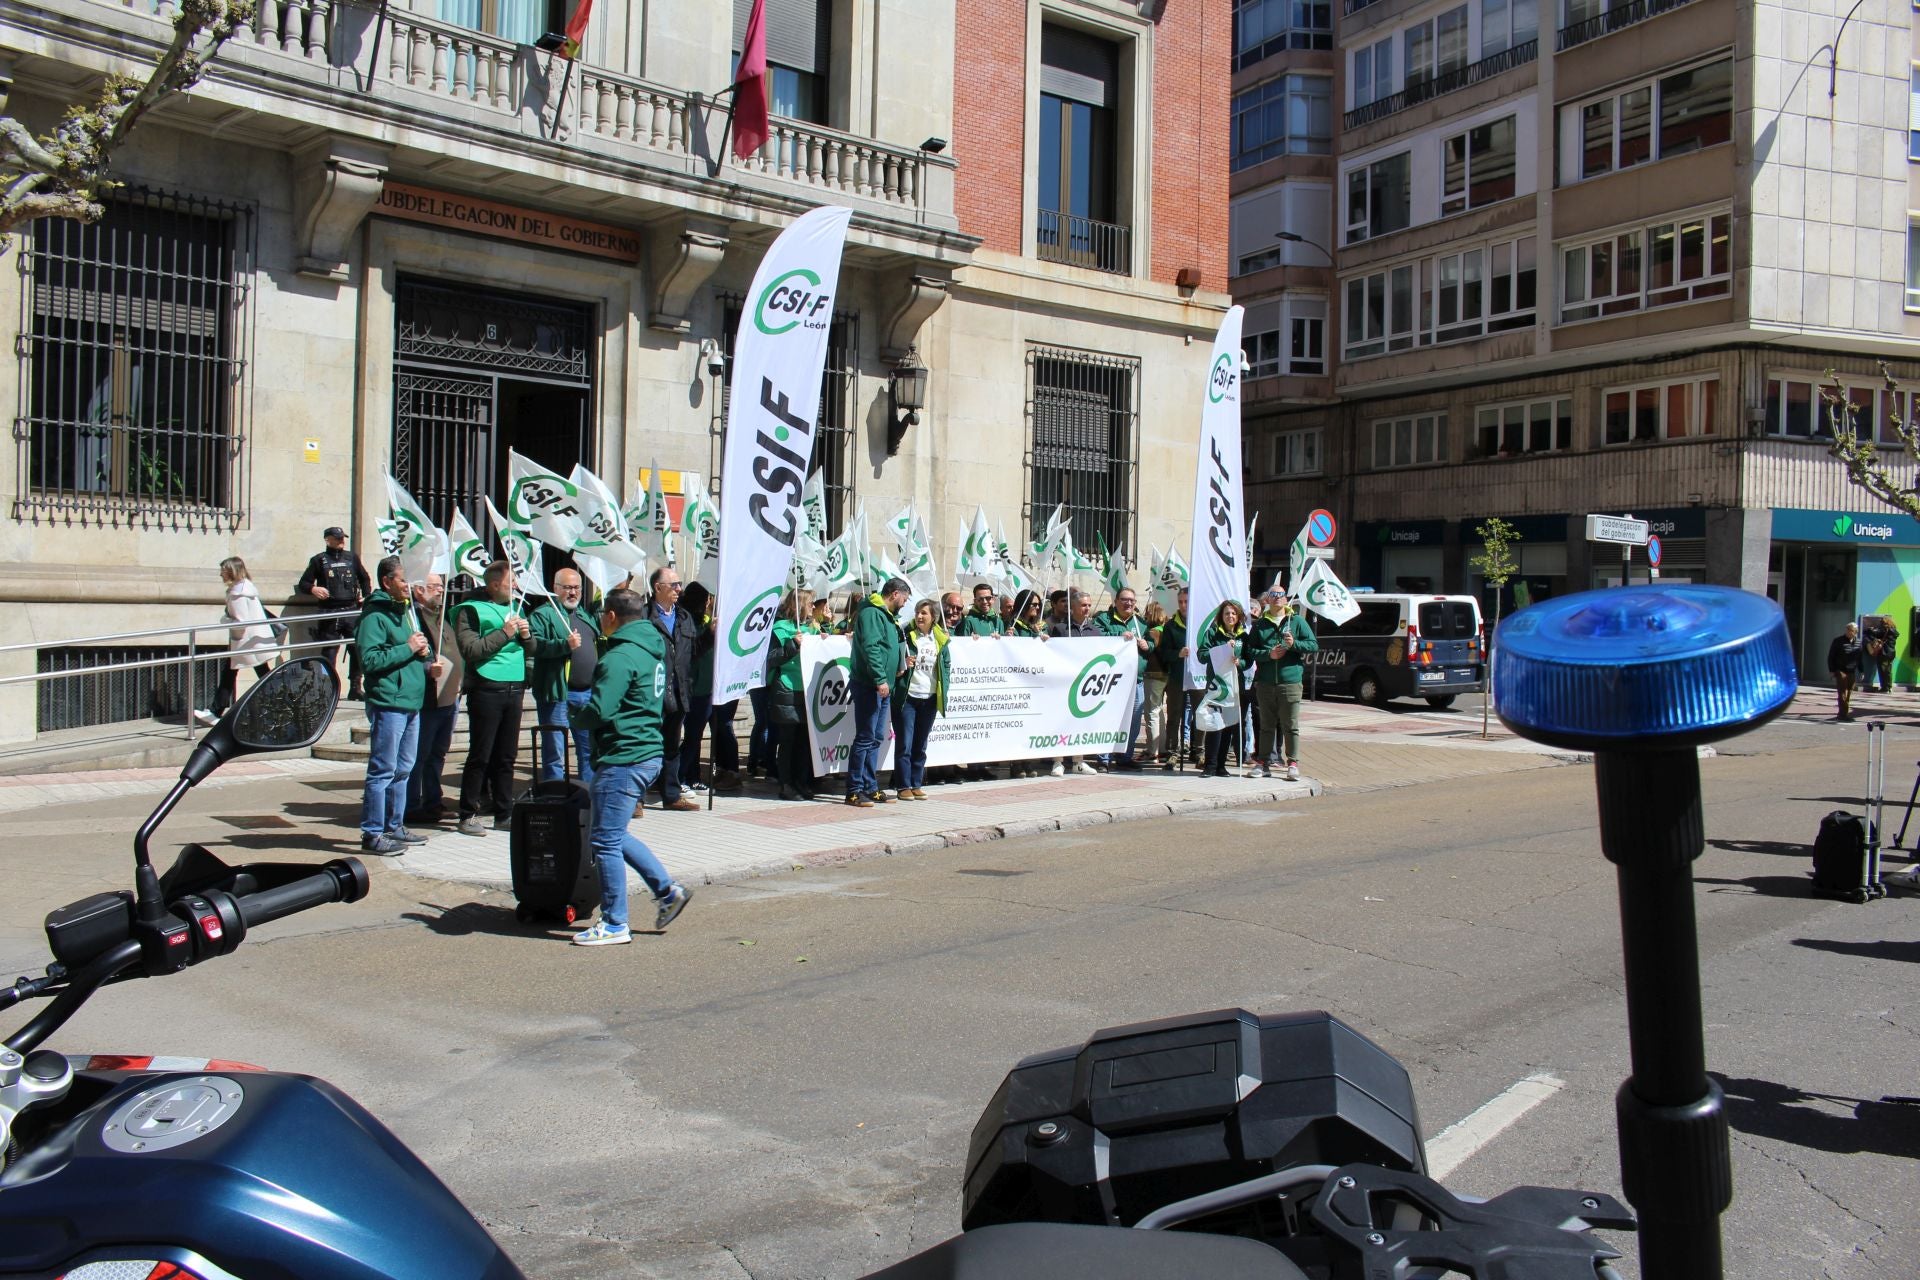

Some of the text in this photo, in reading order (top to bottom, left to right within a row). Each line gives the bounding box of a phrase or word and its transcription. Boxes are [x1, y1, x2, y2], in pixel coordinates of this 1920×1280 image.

[522, 217, 555, 239] DEL
[560, 225, 640, 254] GOBIERNO
[804, 320, 826, 329] León
[488, 325, 496, 338] 6
[1649, 520, 1675, 535] icaja
[1853, 523, 1892, 540] Unicaja
[1391, 530, 1420, 543] Unicaja
[744, 606, 776, 632] CSI
[957, 667, 976, 675] TODAS
[978, 667, 991, 675] LAS
[1031, 667, 1045, 675] QUE
[979, 694, 1012, 702] ANTICIPADA
[958, 704, 989, 712] PERSONAL
[951, 723, 984, 732] INMEDIATA
[928, 733, 962, 743] SUPERIORES
[172, 934, 186, 944] SOS
